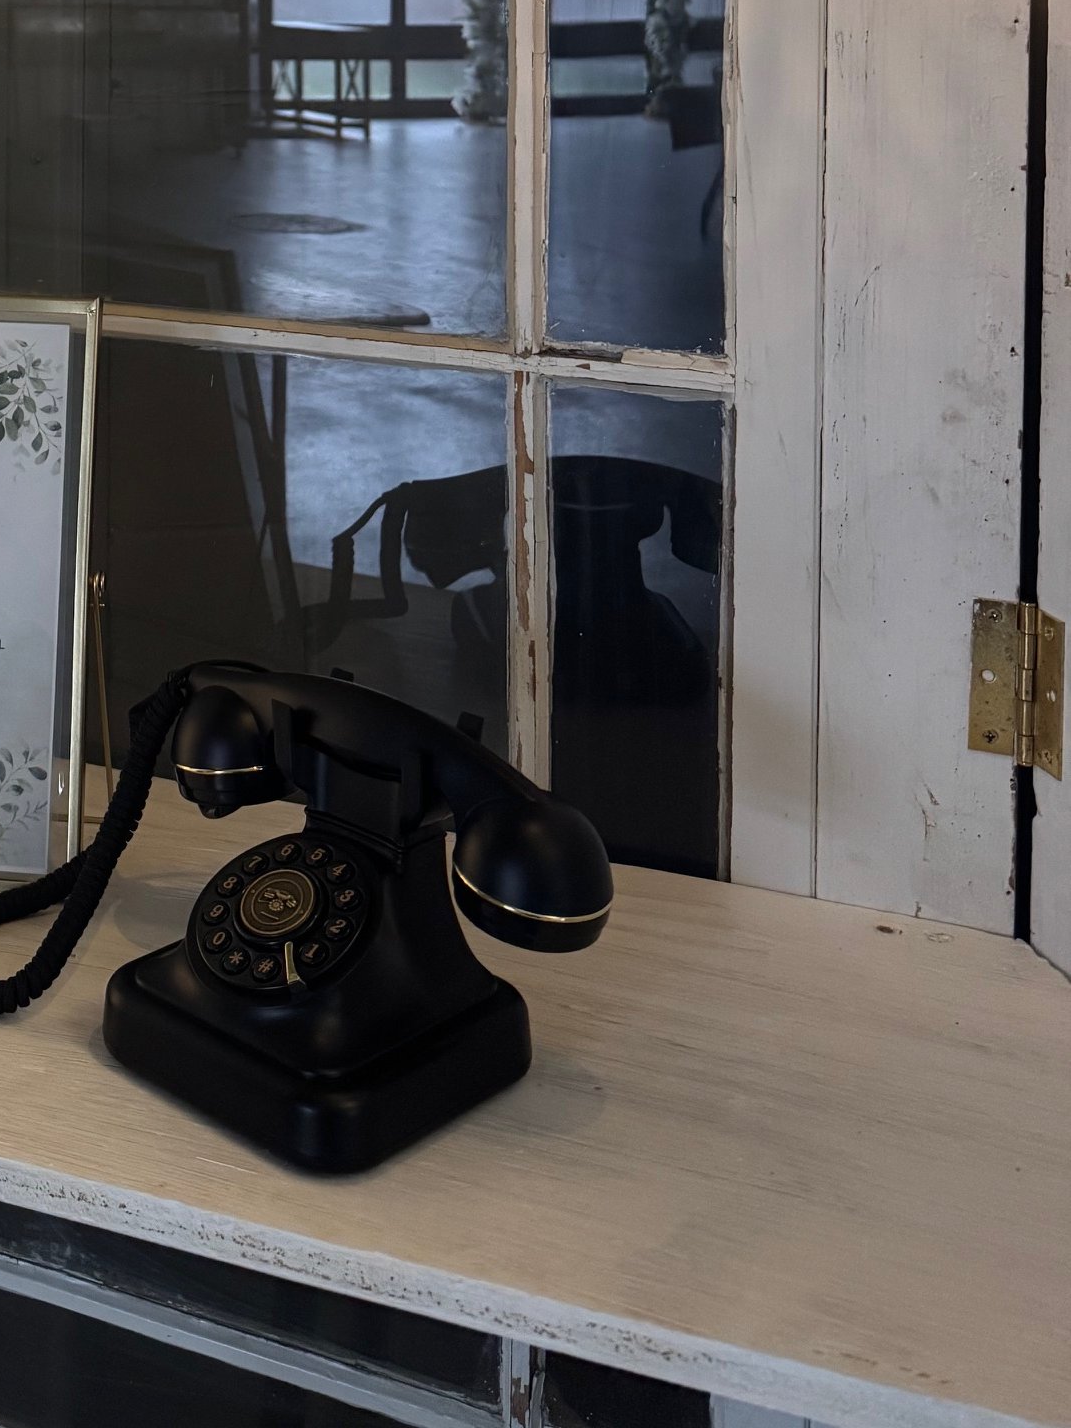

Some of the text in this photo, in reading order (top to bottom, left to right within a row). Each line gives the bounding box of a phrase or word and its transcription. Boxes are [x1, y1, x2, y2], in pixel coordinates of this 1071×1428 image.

[281, 844, 294, 856] 6
[311, 849, 324, 860] 5
[248, 856, 262, 868] 7
[333, 864, 347, 876] 4
[223, 877, 237, 888] 8
[340, 890, 354, 902] 3
[210, 905, 224, 917] 9
[329, 920, 345, 933] 2
[213, 932, 225, 944] 0
[305, 944, 318, 958] 1
